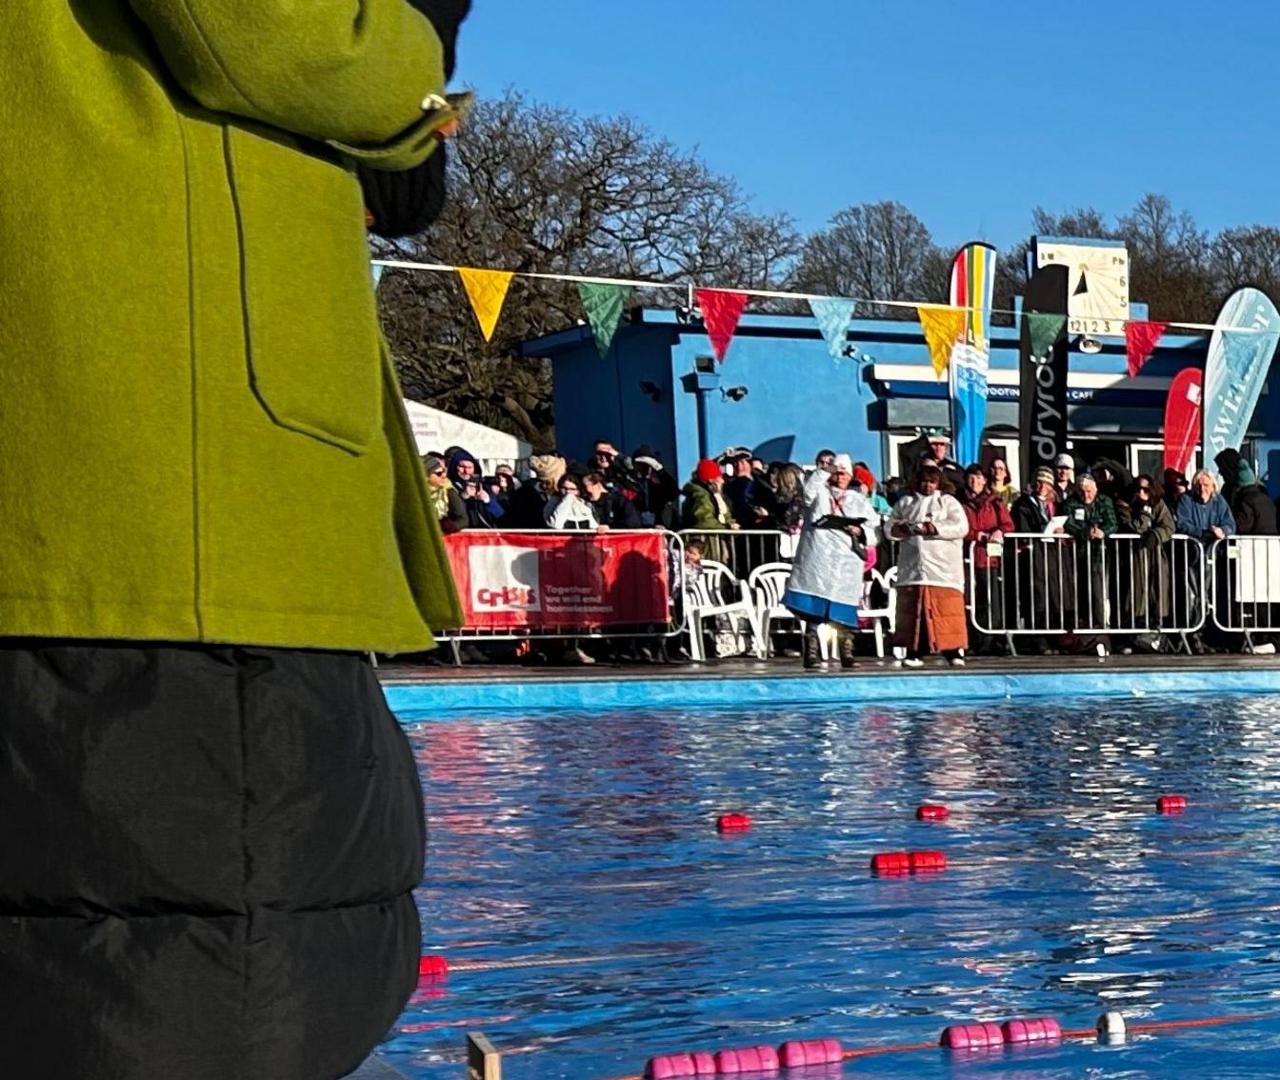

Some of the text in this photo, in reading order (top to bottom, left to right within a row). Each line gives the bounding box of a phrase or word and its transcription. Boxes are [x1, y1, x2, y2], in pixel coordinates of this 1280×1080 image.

[1119, 275, 1127, 288] 6
[1119, 295, 1128, 308] 5
[1070, 319, 1081, 332] 12
[1091, 320, 1099, 333] 2
[1103, 320, 1111, 333] 3
[986, 386, 1020, 397] OOTIN
[1031, 345, 1061, 461] dryro
[477, 586, 537, 607] crisis
